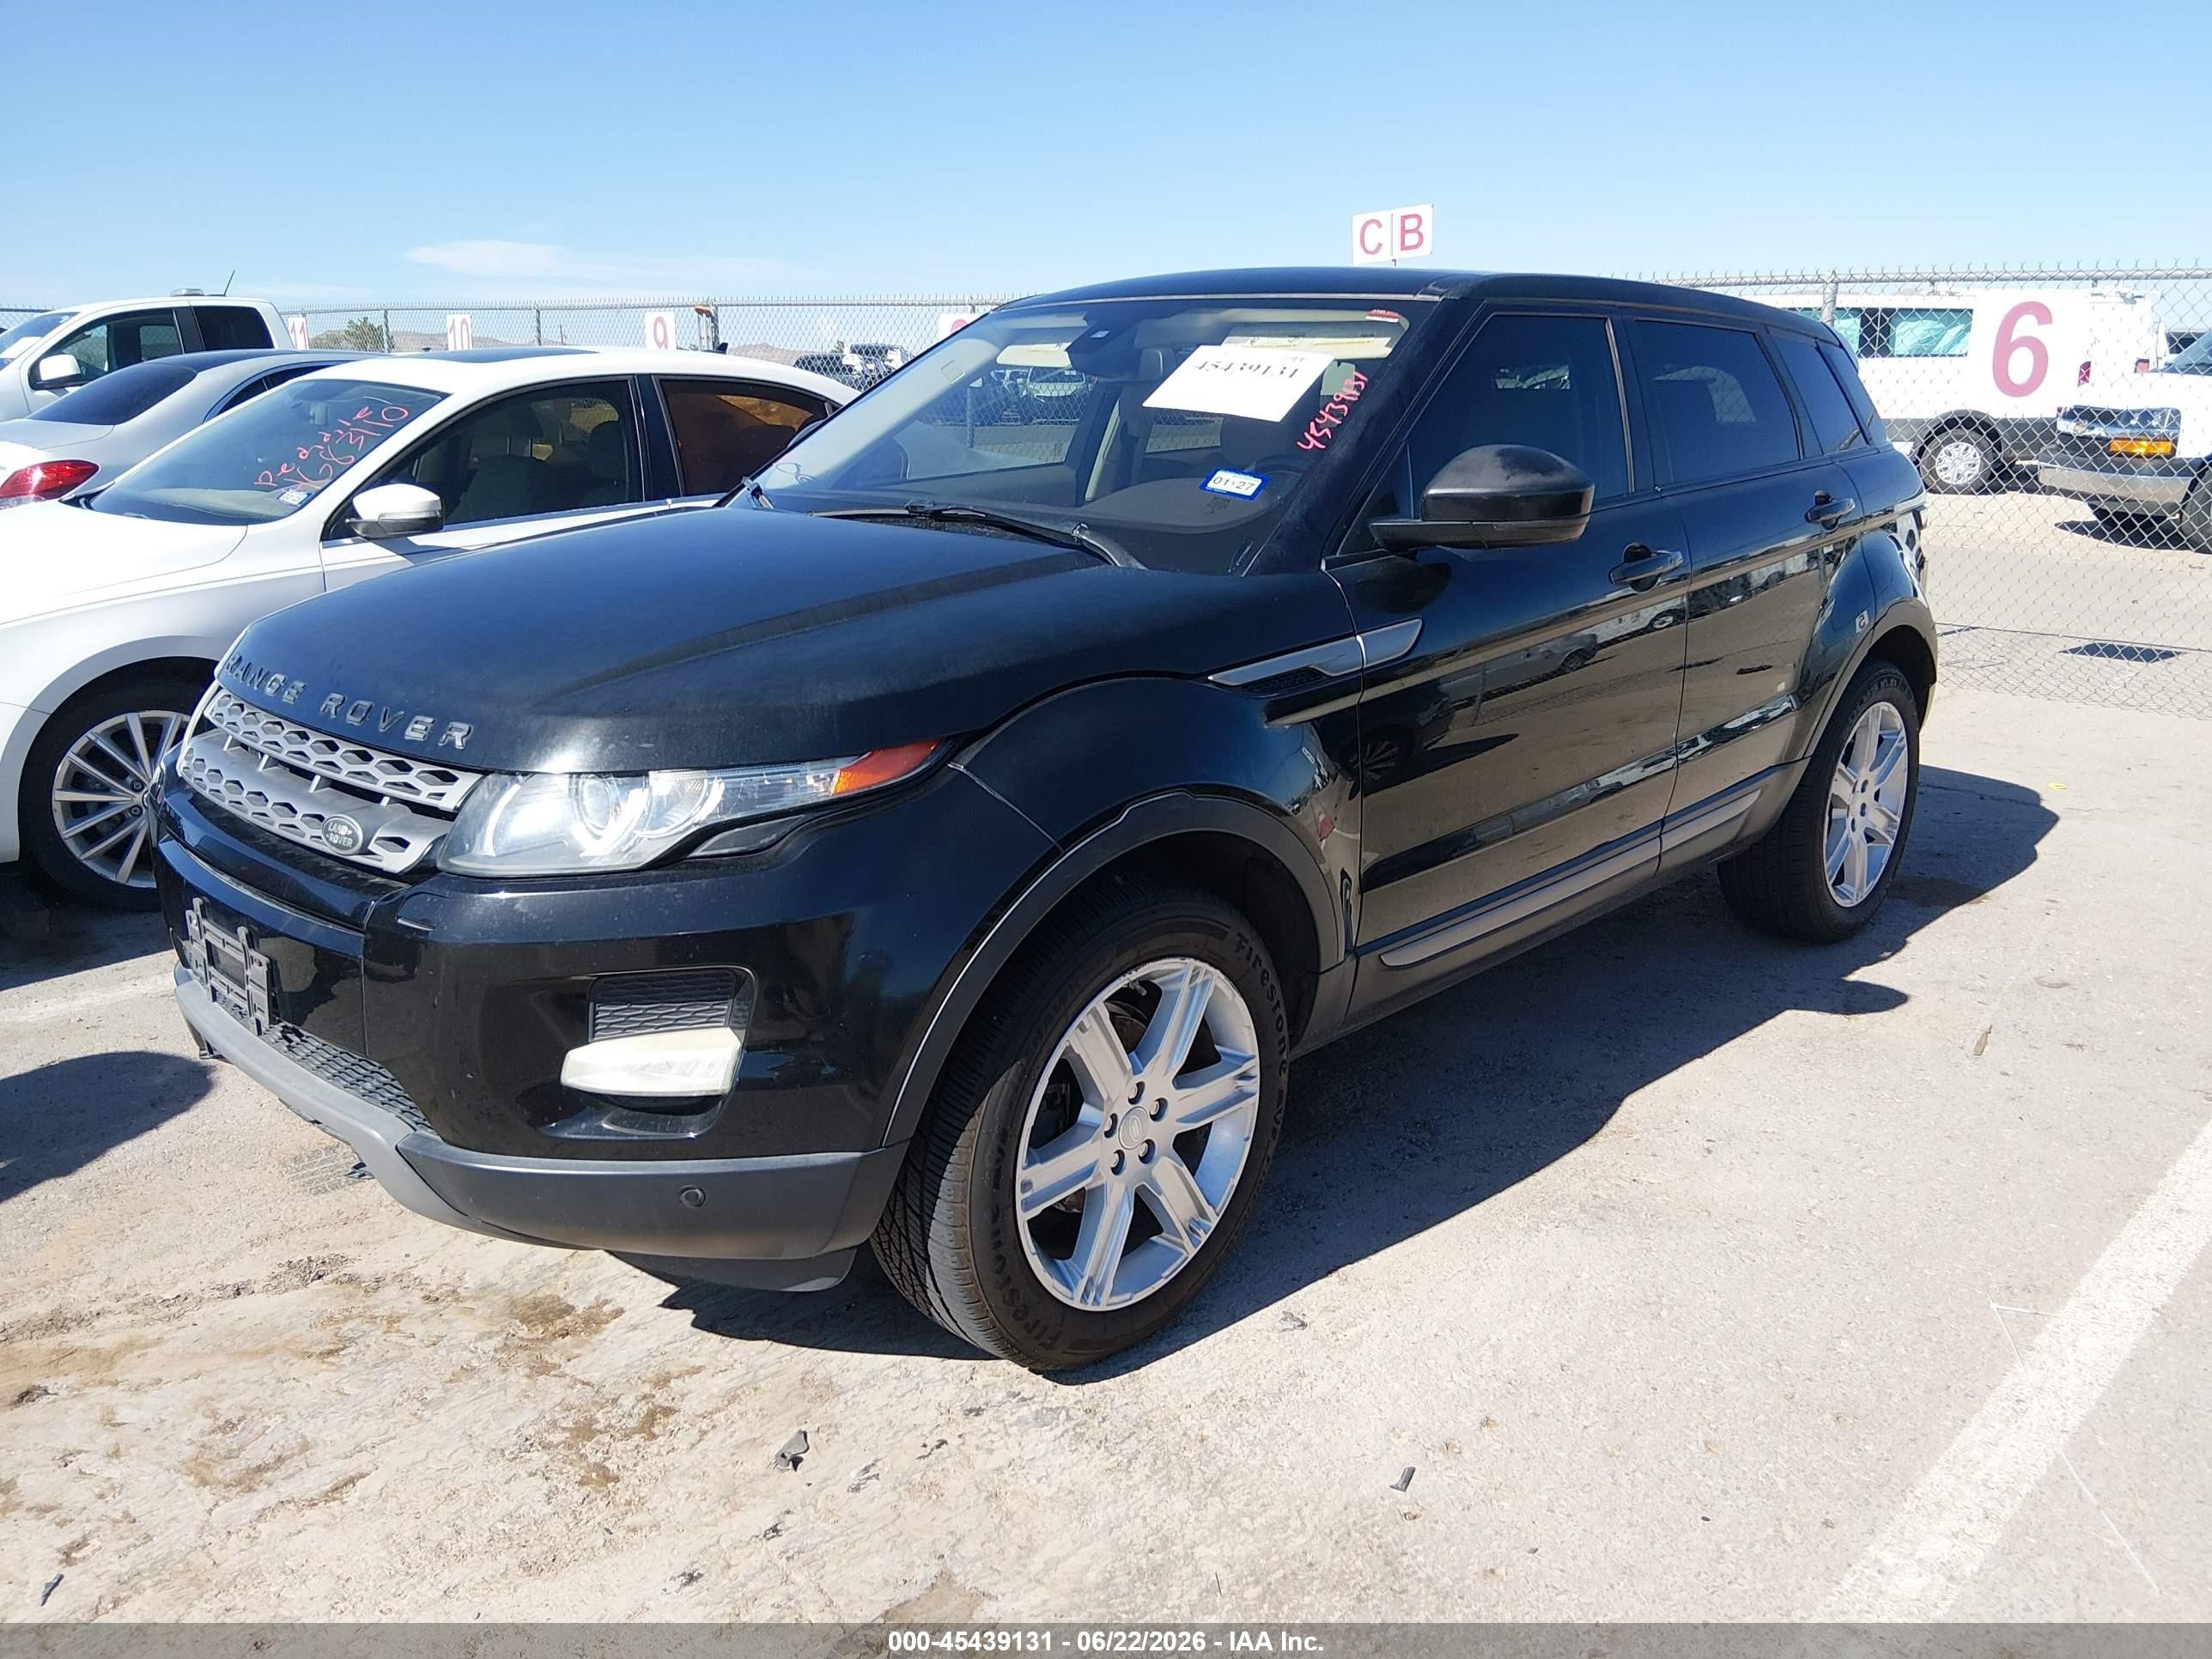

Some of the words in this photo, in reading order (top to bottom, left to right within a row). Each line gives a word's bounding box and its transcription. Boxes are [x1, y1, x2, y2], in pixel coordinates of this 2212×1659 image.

[1360, 218, 1382, 255] C
[1401, 214, 1424, 251] B
[1992, 301, 2053, 398] 6
[224, 653, 307, 705] RANGE
[319, 692, 473, 750] ROVER
[329, 833, 353, 848] ROVER
